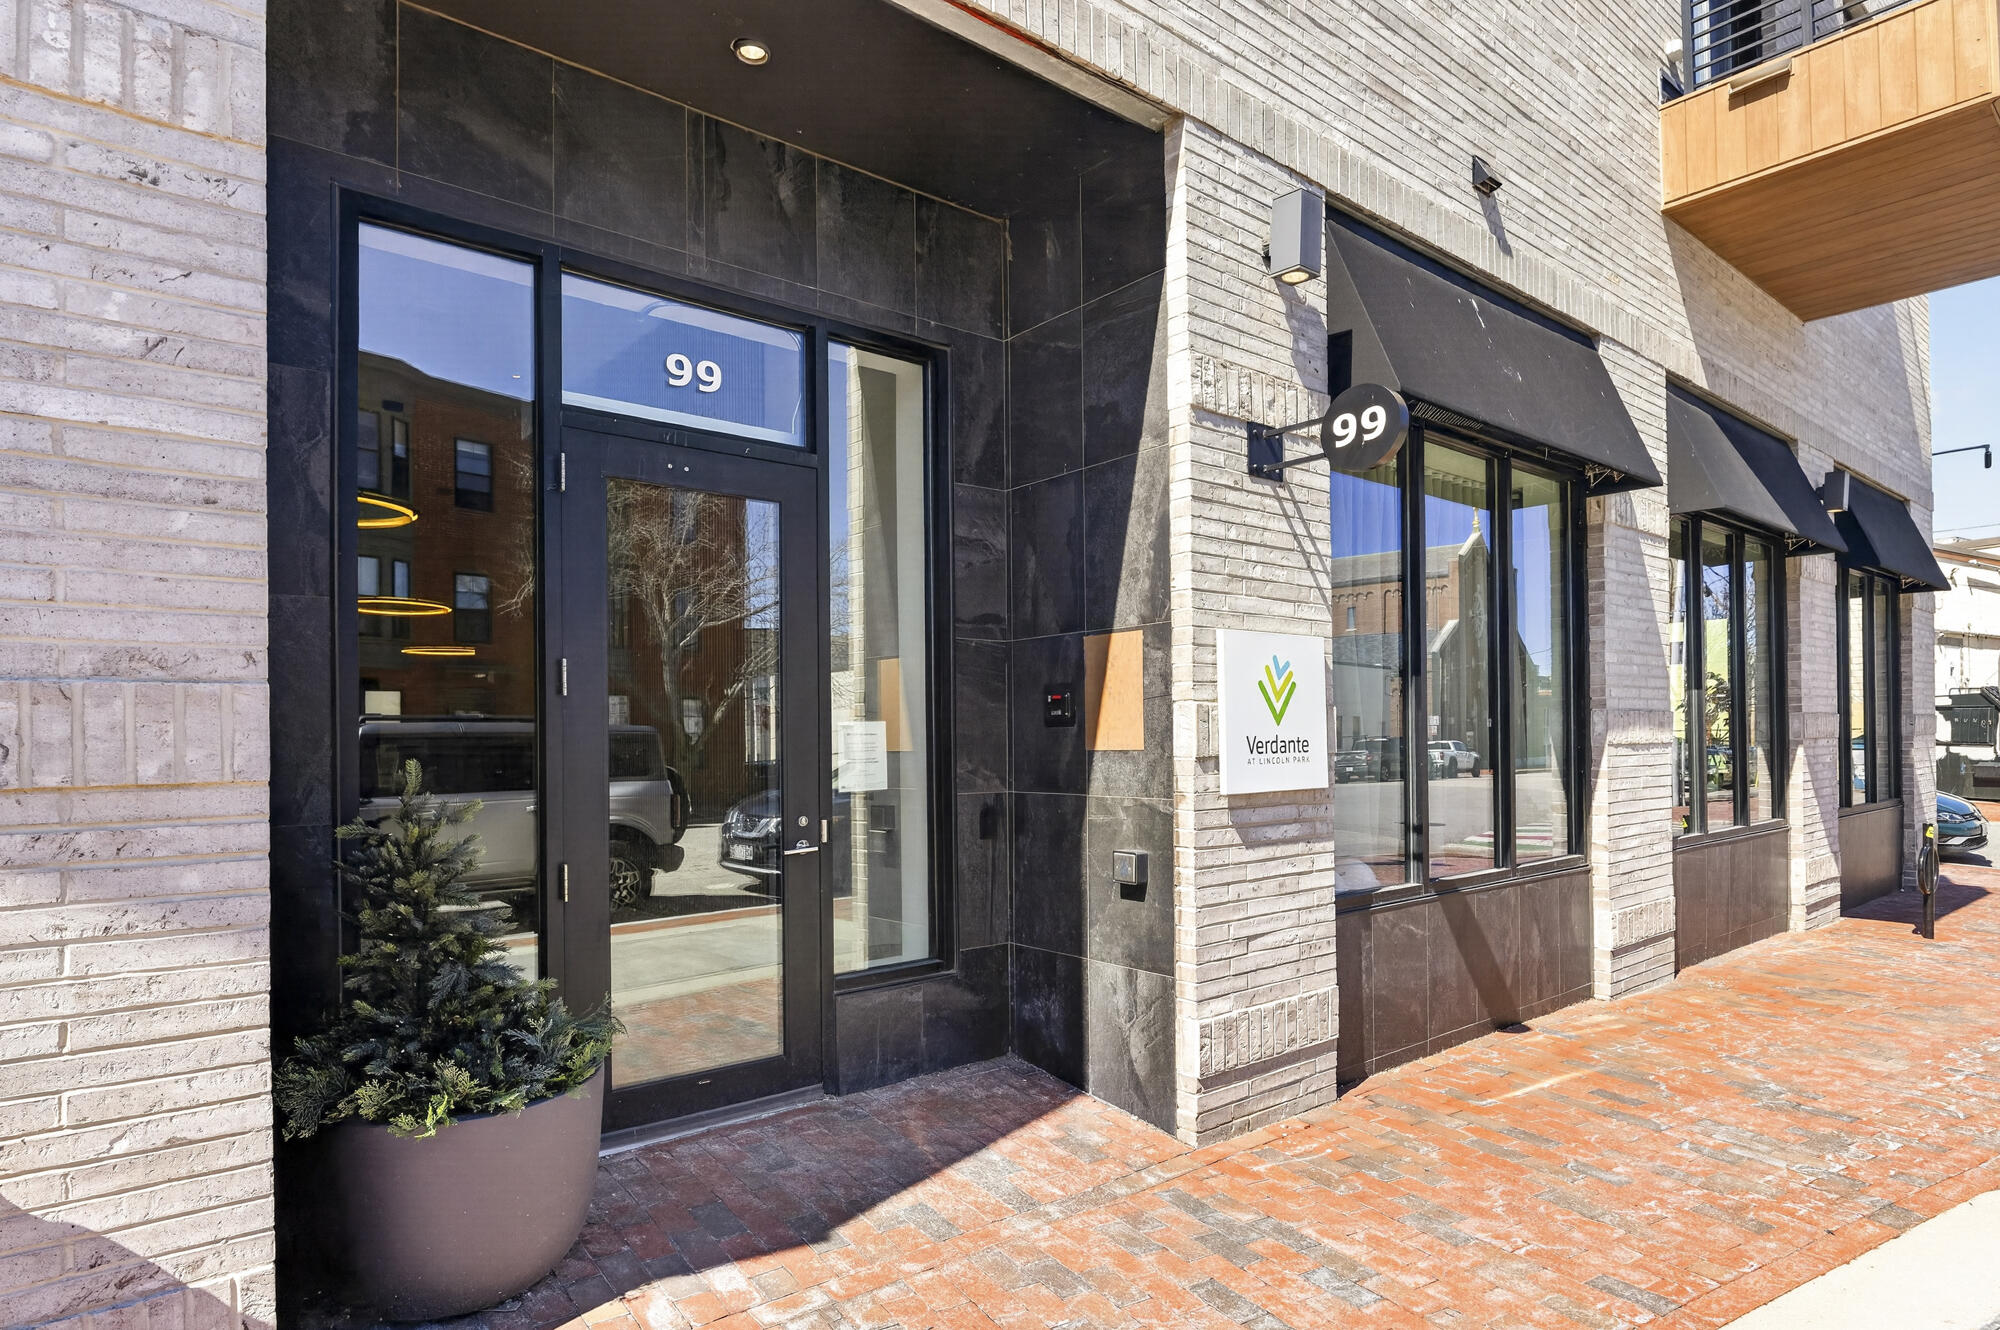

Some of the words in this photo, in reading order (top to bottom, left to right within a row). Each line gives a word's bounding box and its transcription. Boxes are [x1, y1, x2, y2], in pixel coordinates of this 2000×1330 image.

[666, 353, 722, 393] 99
[1333, 405, 1387, 448] 99
[1246, 734, 1310, 755] Verdante
[1247, 757, 1256, 765] AT
[1259, 756, 1290, 765] LINCOLN
[1293, 755, 1311, 764] PARK
